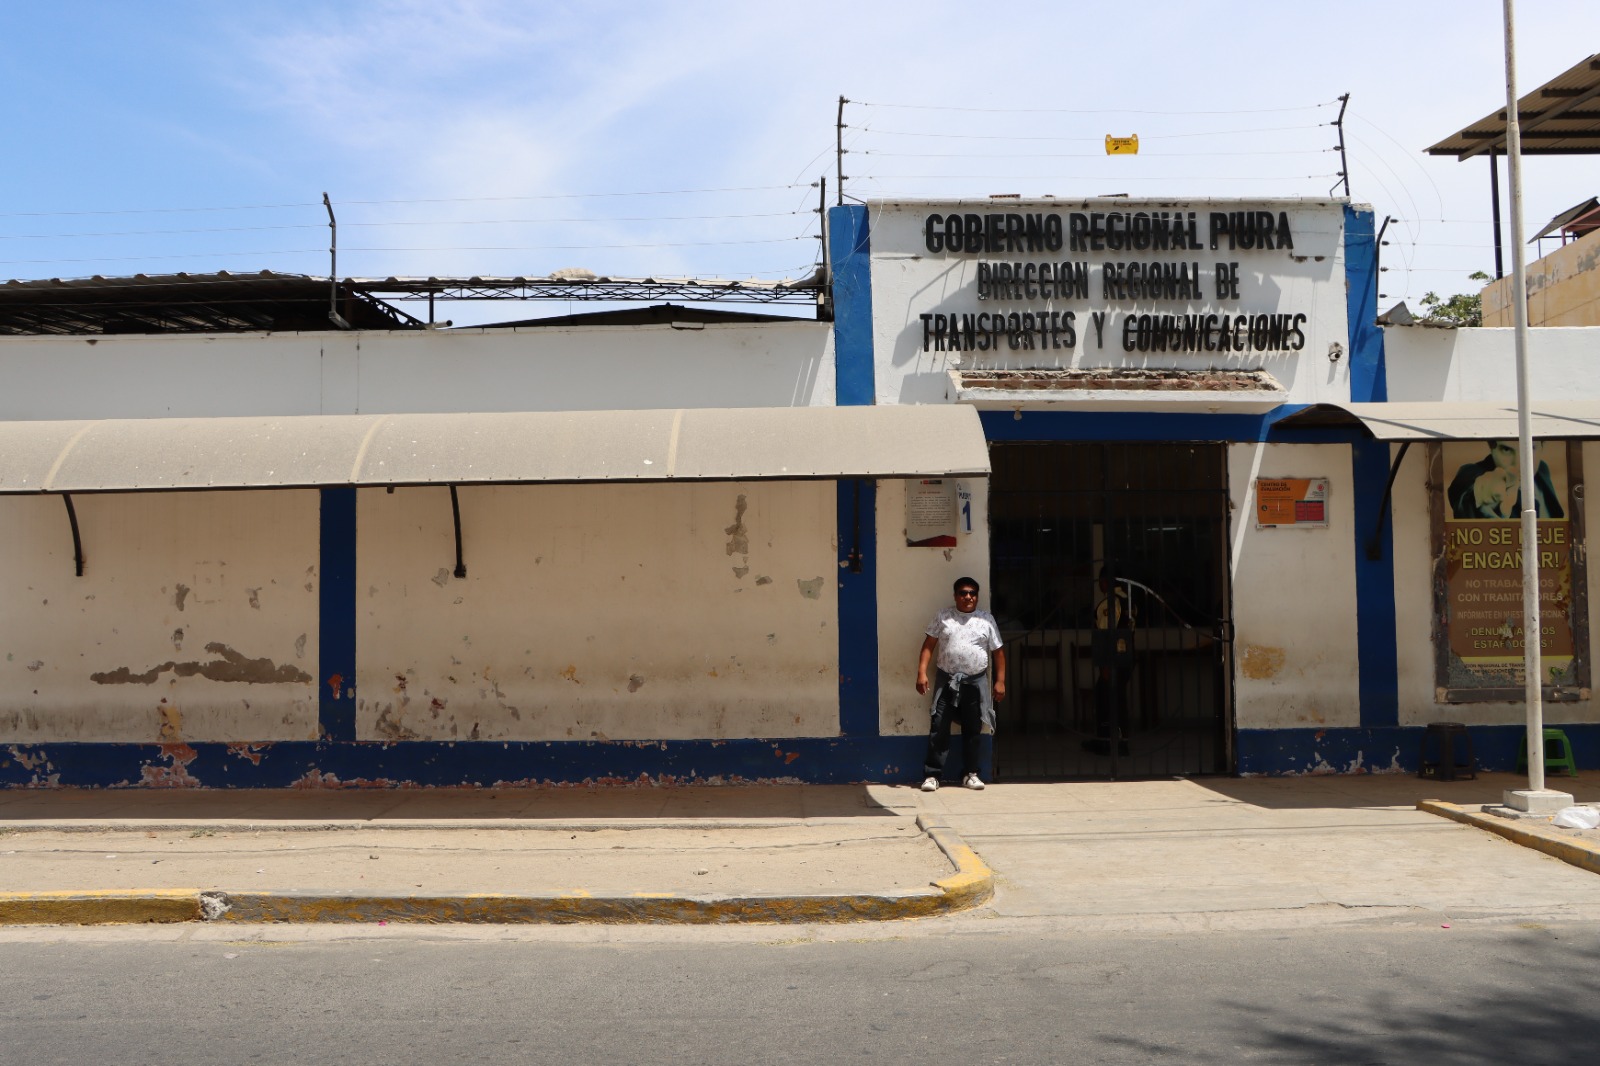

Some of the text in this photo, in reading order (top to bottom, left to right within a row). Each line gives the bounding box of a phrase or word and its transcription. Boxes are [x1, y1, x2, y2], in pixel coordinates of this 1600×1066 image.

[925, 211, 1294, 254] GOBIERNO REGIONAL PIURA
[977, 261, 1240, 301] DIRECCION REGIONAL DE
[919, 311, 1307, 352] TRANSPORTES Y COMUNICACIONES
[963, 501, 971, 531] 1
[1489, 528, 1512, 545] SE
[1518, 527, 1565, 545] EJE
[1462, 548, 1559, 569] ENGAÑR!
[1465, 579, 1554, 589] NO TRABAJOS
[1457, 593, 1480, 602] CON
[1539, 626, 1556, 635] OS
